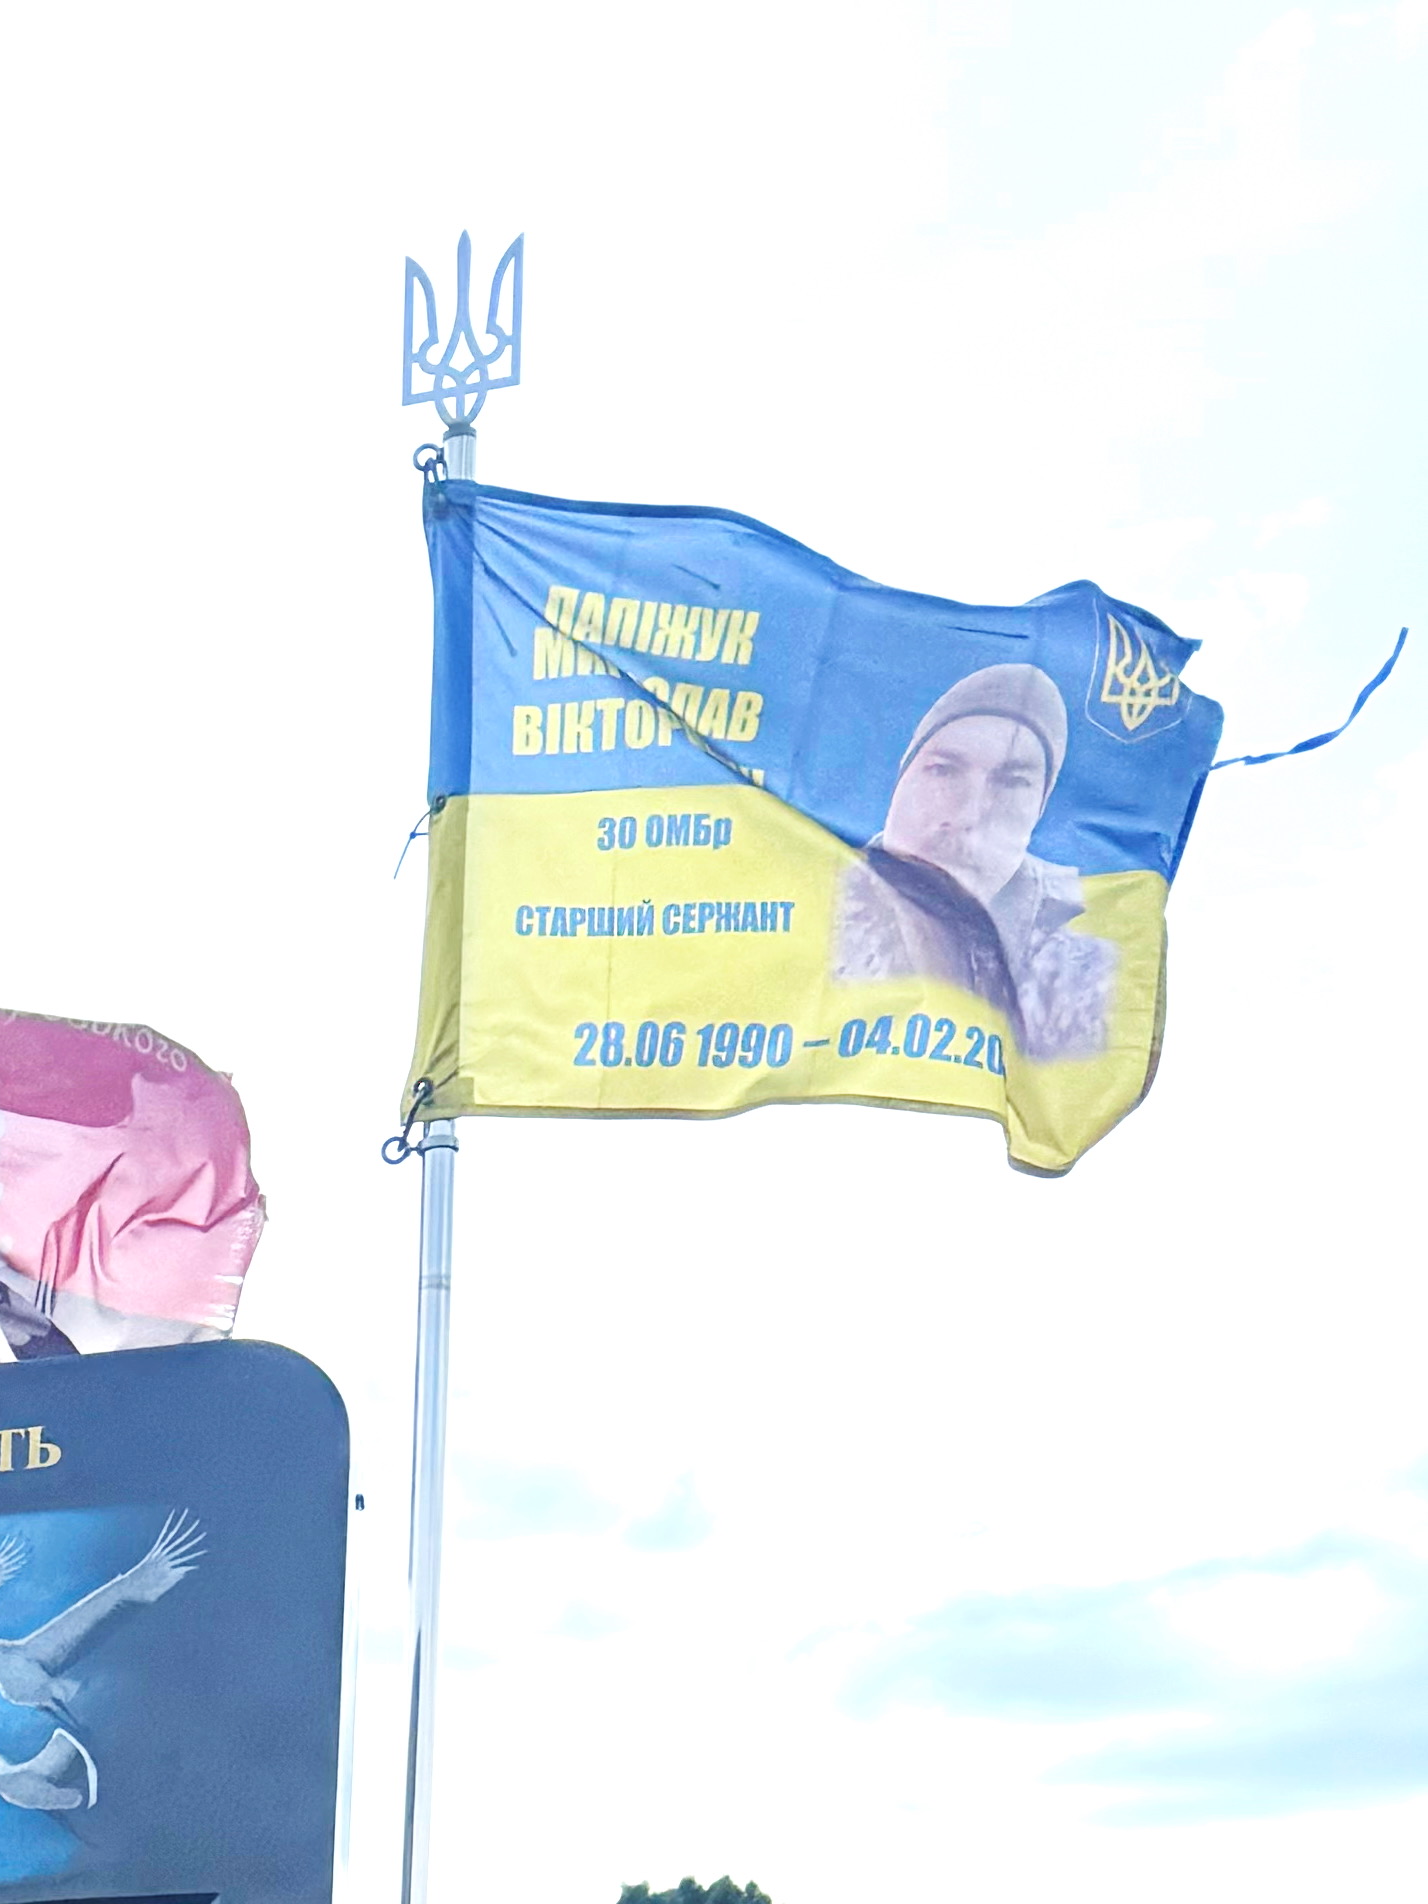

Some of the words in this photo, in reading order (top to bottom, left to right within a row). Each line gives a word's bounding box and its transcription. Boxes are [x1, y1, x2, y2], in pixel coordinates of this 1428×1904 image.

[545, 585, 760, 665] ПАПІЖУК
[597, 816, 637, 851] 30
[645, 814, 733, 851] ОМБр
[515, 898, 656, 938] СТАРШИЙ
[662, 901, 795, 934] СЕРЖАНТ
[573, 1021, 686, 1068] 28.06
[697, 1022, 793, 1069] 1990
[838, 1012, 1006, 1076] 04.02.20
